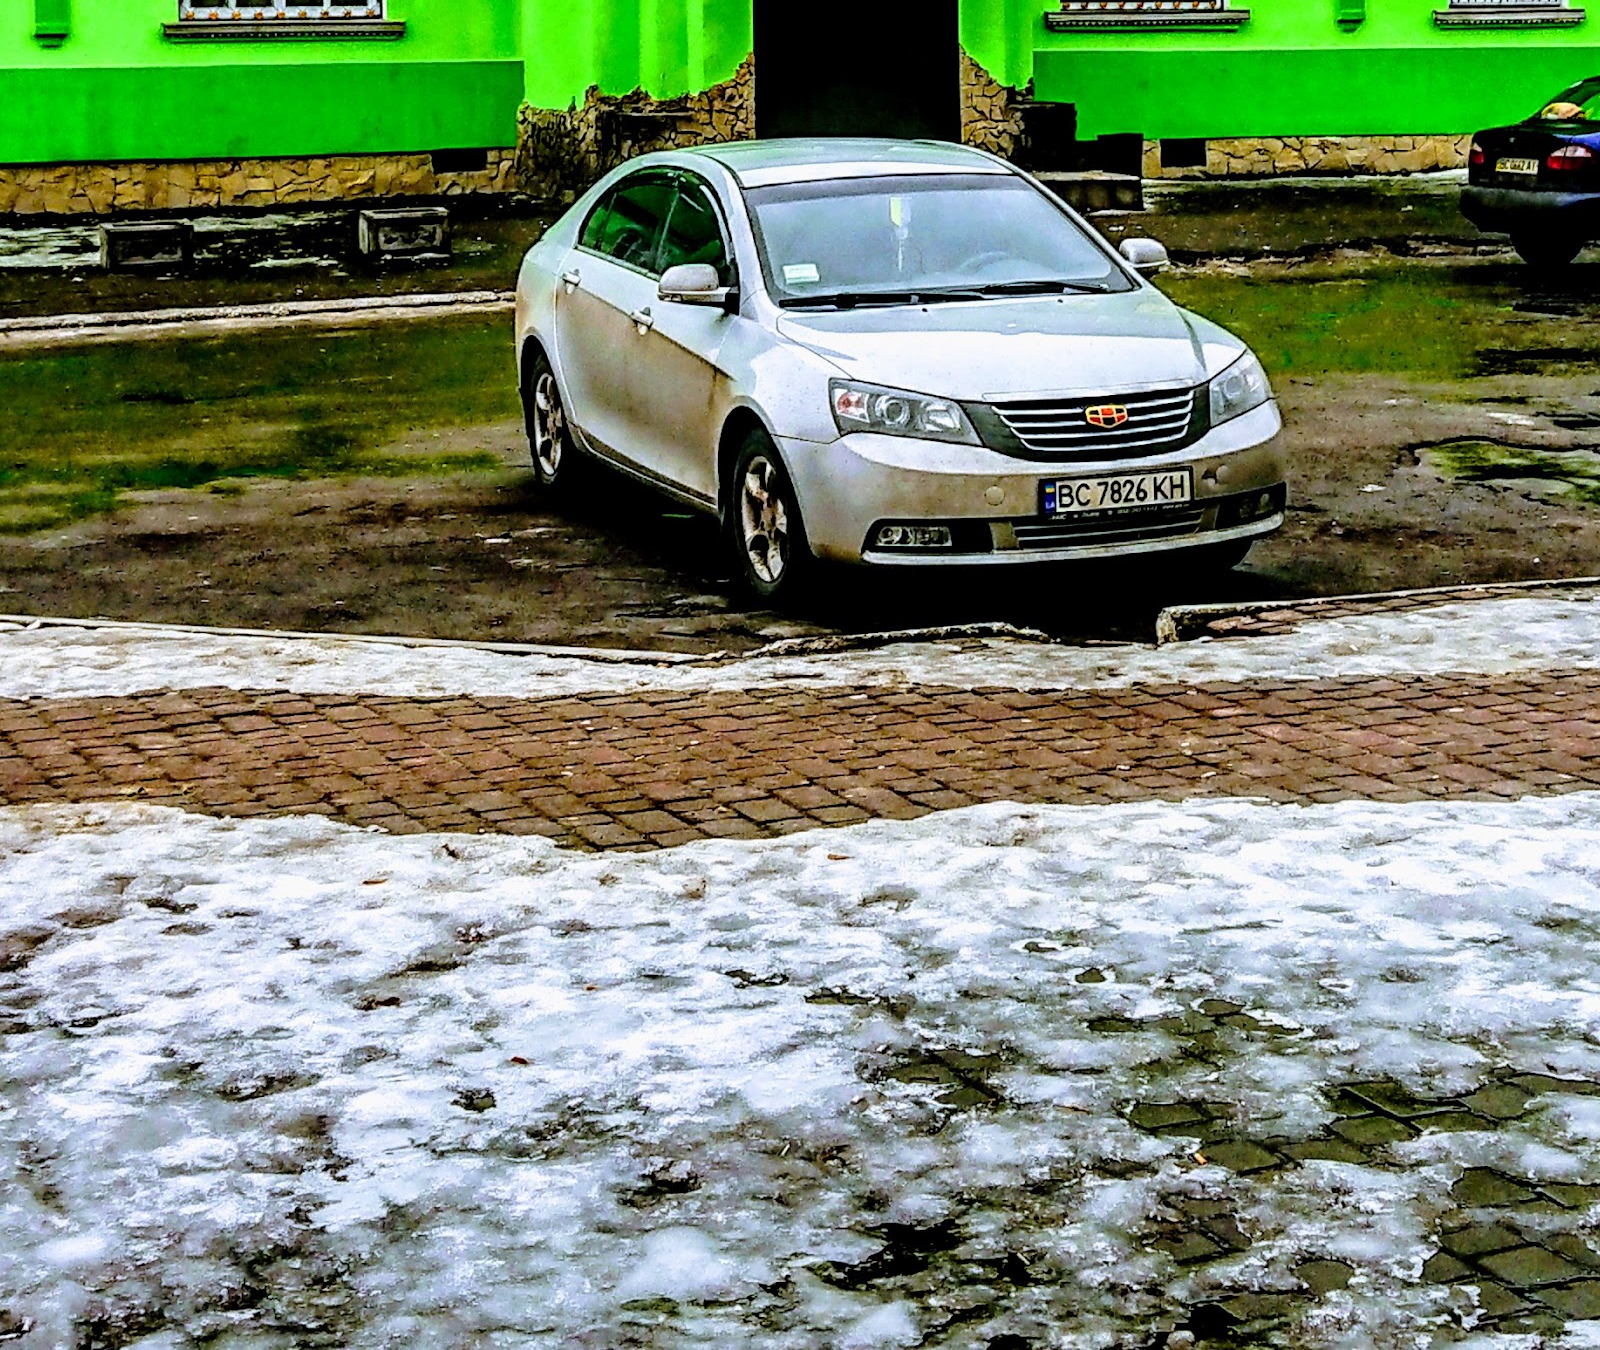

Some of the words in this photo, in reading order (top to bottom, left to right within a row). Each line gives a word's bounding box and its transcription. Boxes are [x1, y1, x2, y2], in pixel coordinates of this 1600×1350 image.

[1058, 483, 1090, 508] BC
[1097, 478, 1148, 506] 7826
[1153, 474, 1185, 501] KH
